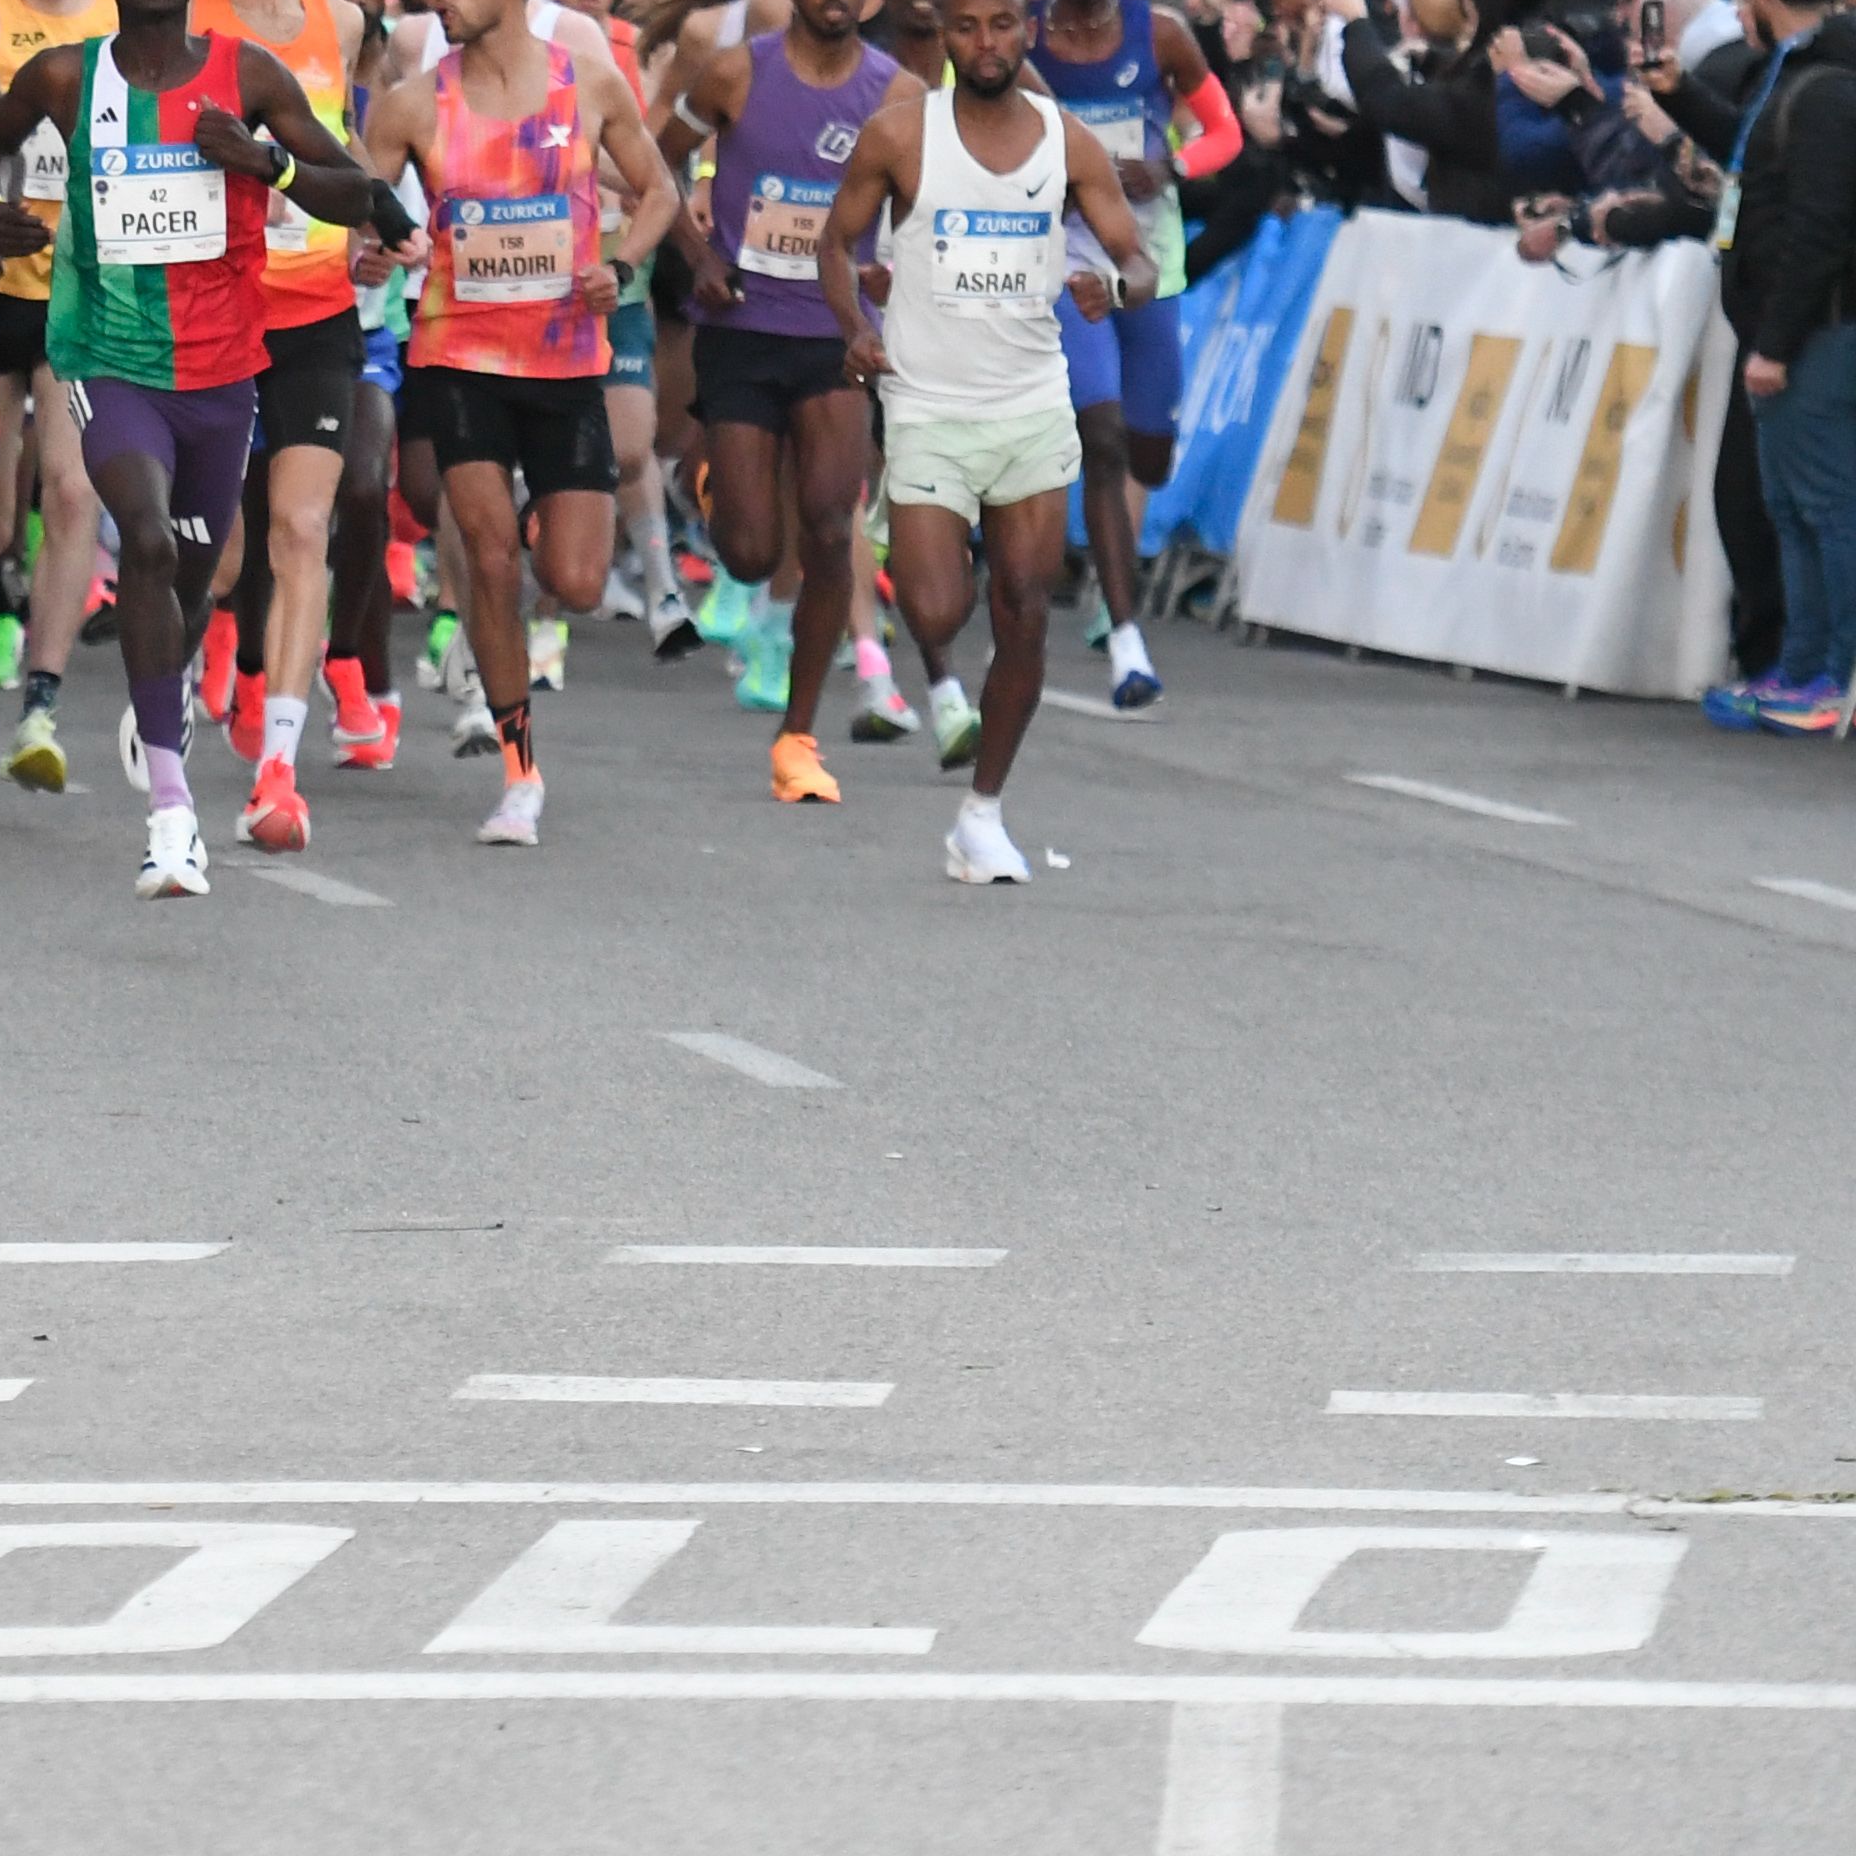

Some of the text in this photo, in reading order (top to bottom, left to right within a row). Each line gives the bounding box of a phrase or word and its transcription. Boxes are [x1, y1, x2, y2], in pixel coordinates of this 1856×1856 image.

[149, 189, 168, 203] 42
[491, 203, 556, 221] ZURICH
[120, 210, 198, 235] PACER
[975, 216, 1039, 233] ZURICH
[468, 254, 557, 278] KHADIRI
[989, 251, 999, 264] 3
[955, 272, 1027, 293] ASRAR
